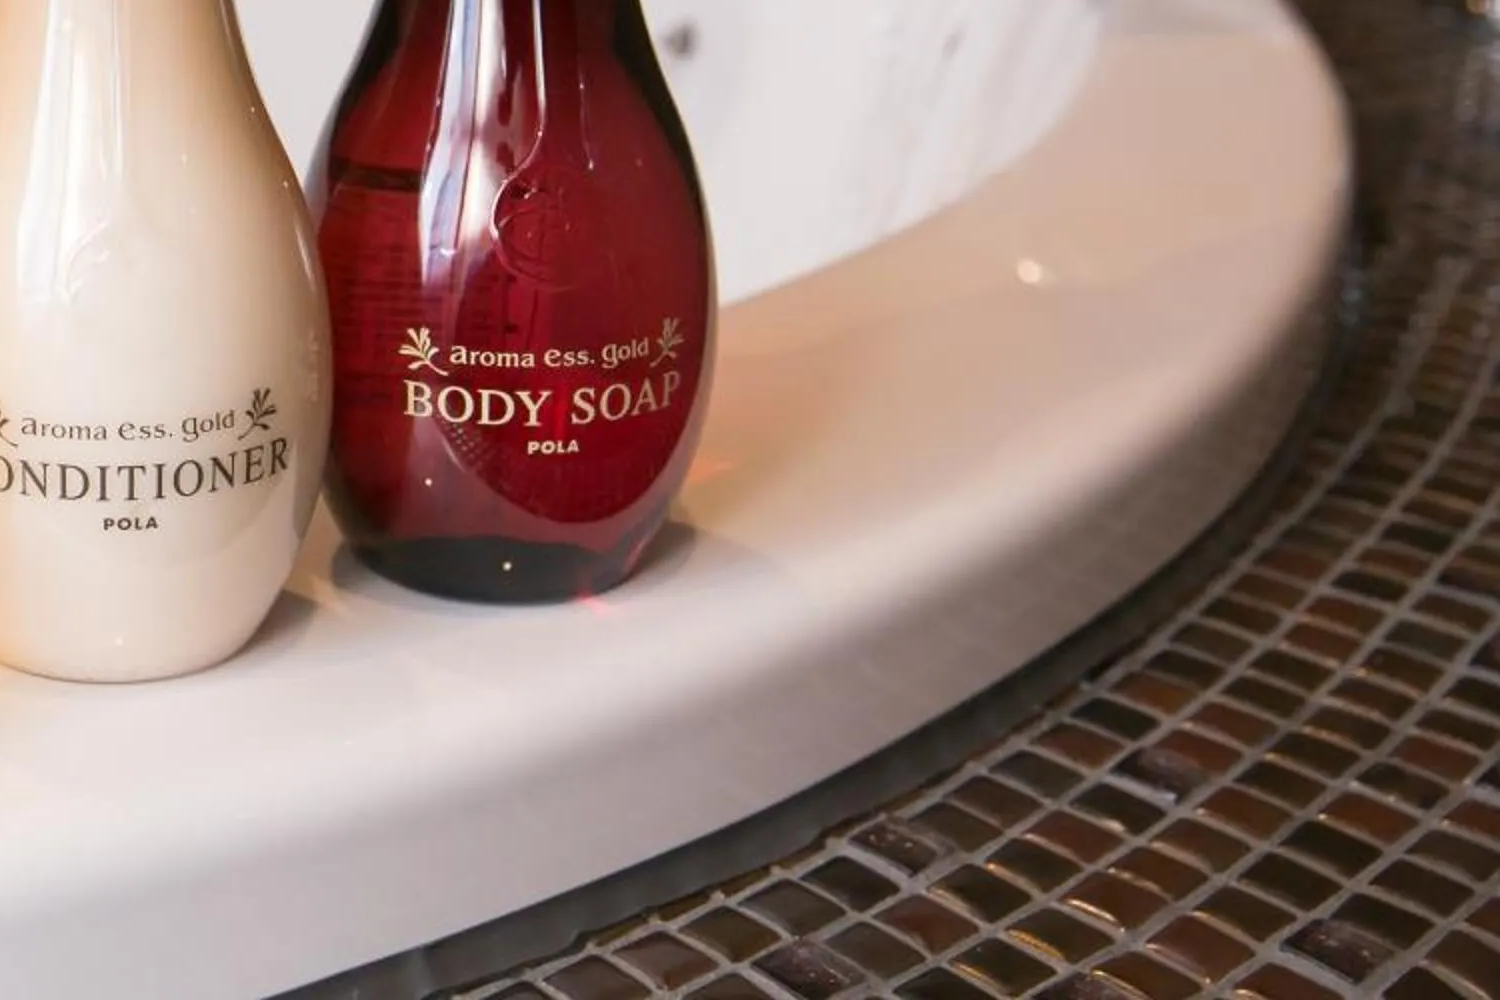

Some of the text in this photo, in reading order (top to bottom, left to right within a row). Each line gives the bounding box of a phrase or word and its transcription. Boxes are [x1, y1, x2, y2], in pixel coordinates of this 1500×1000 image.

[450, 337, 650, 369] aroma ess. gold
[404, 371, 681, 427] BODY SOAP
[20, 409, 236, 443] aroma ess. gold
[527, 439, 580, 455] POLA
[103, 516, 159, 531] POLA
